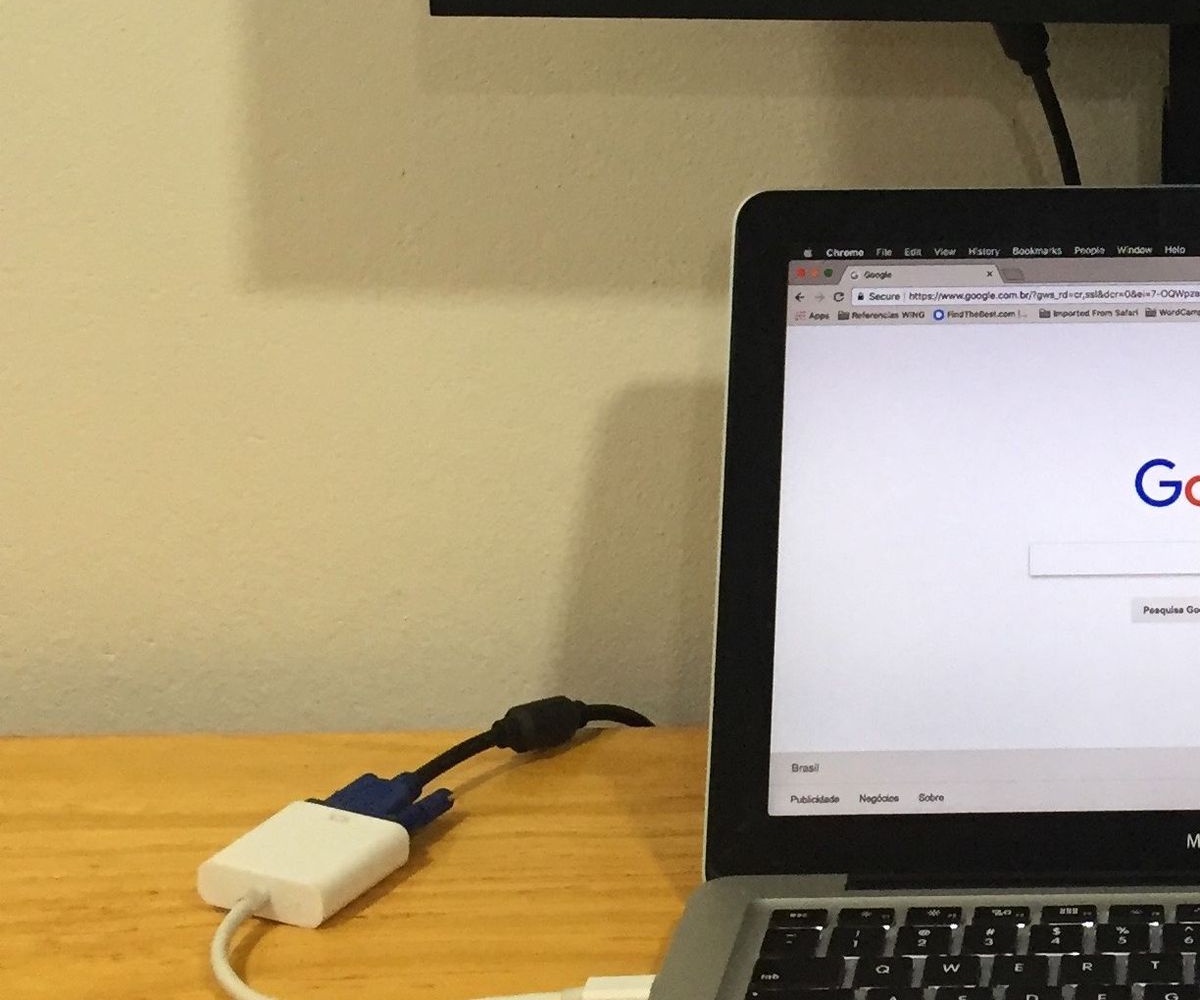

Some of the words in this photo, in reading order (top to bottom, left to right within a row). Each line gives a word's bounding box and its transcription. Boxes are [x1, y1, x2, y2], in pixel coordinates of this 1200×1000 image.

[825, 248, 865, 258] Chrome
[875, 247, 893, 257] File
[904, 247, 922, 257] Edit
[933, 247, 957, 257] View
[968, 247, 1001, 257] History
[1012, 246, 1063, 256] Bookmarks
[1074, 246, 1106, 256] People
[1116, 245, 1153, 255] Window
[1164, 245, 1186, 255] Help
[868, 291, 901, 301] Secure
[1143, 605, 1184, 617] Pesquisa
[791, 762, 820, 773] Brasil
[875, 964, 890, 974] Q
[942, 963, 961, 973] W
[1082, 962, 1093, 971] R
[1150, 960, 1160, 970] T
